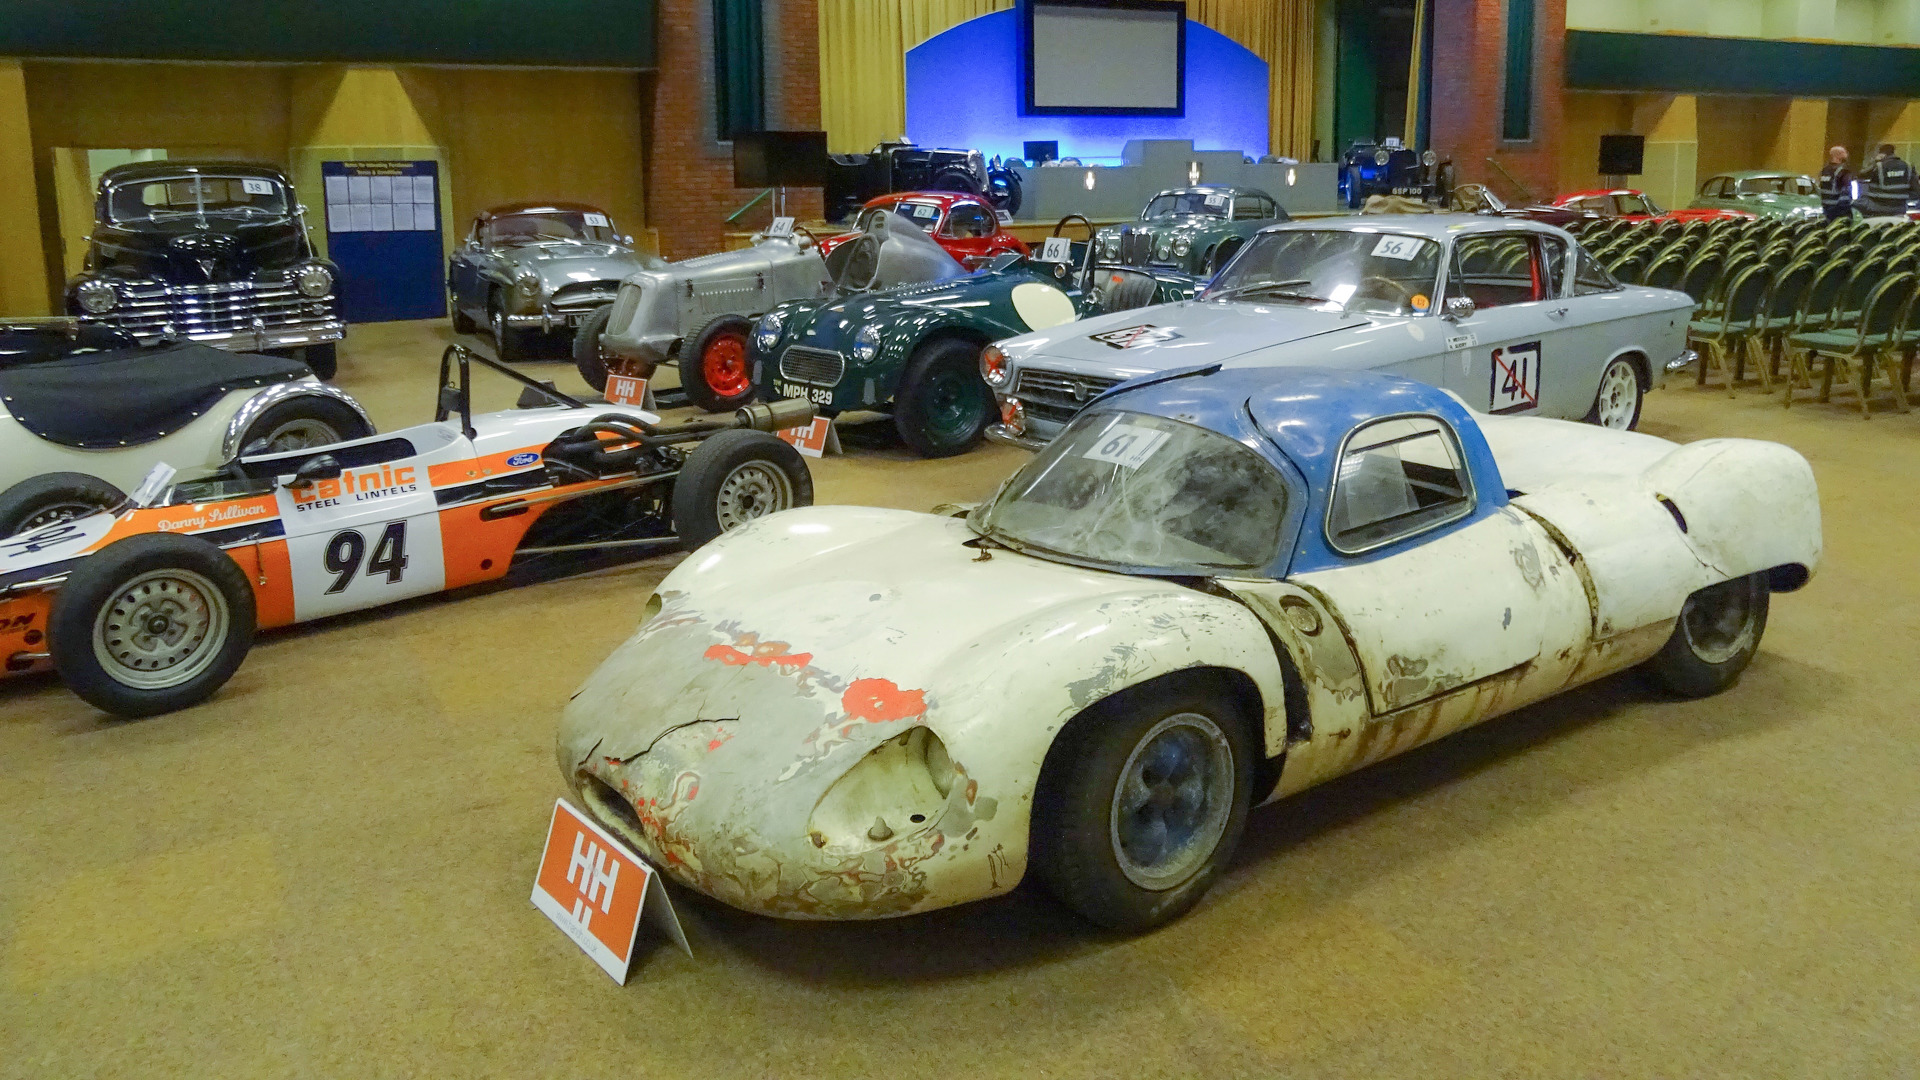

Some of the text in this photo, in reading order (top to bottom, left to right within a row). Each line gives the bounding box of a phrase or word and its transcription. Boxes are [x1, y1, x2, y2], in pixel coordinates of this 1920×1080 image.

[248, 182, 262, 191] 38
[773, 221, 786, 232] 64
[1046, 243, 1061, 259] 66
[1380, 240, 1404, 255] 56
[615, 379, 637, 398] HH
[1501, 357, 1528, 401] 41
[783, 383, 809, 399] MPH
[811, 388, 833, 406] 329
[1100, 433, 1139, 458] 61
[291, 464, 417, 505] catnic
[296, 484, 418, 513] STEEL LINTELS
[158, 504, 267, 532] Danny Sullivan
[323, 519, 410, 596] 94
[566, 830, 621, 916] HH
